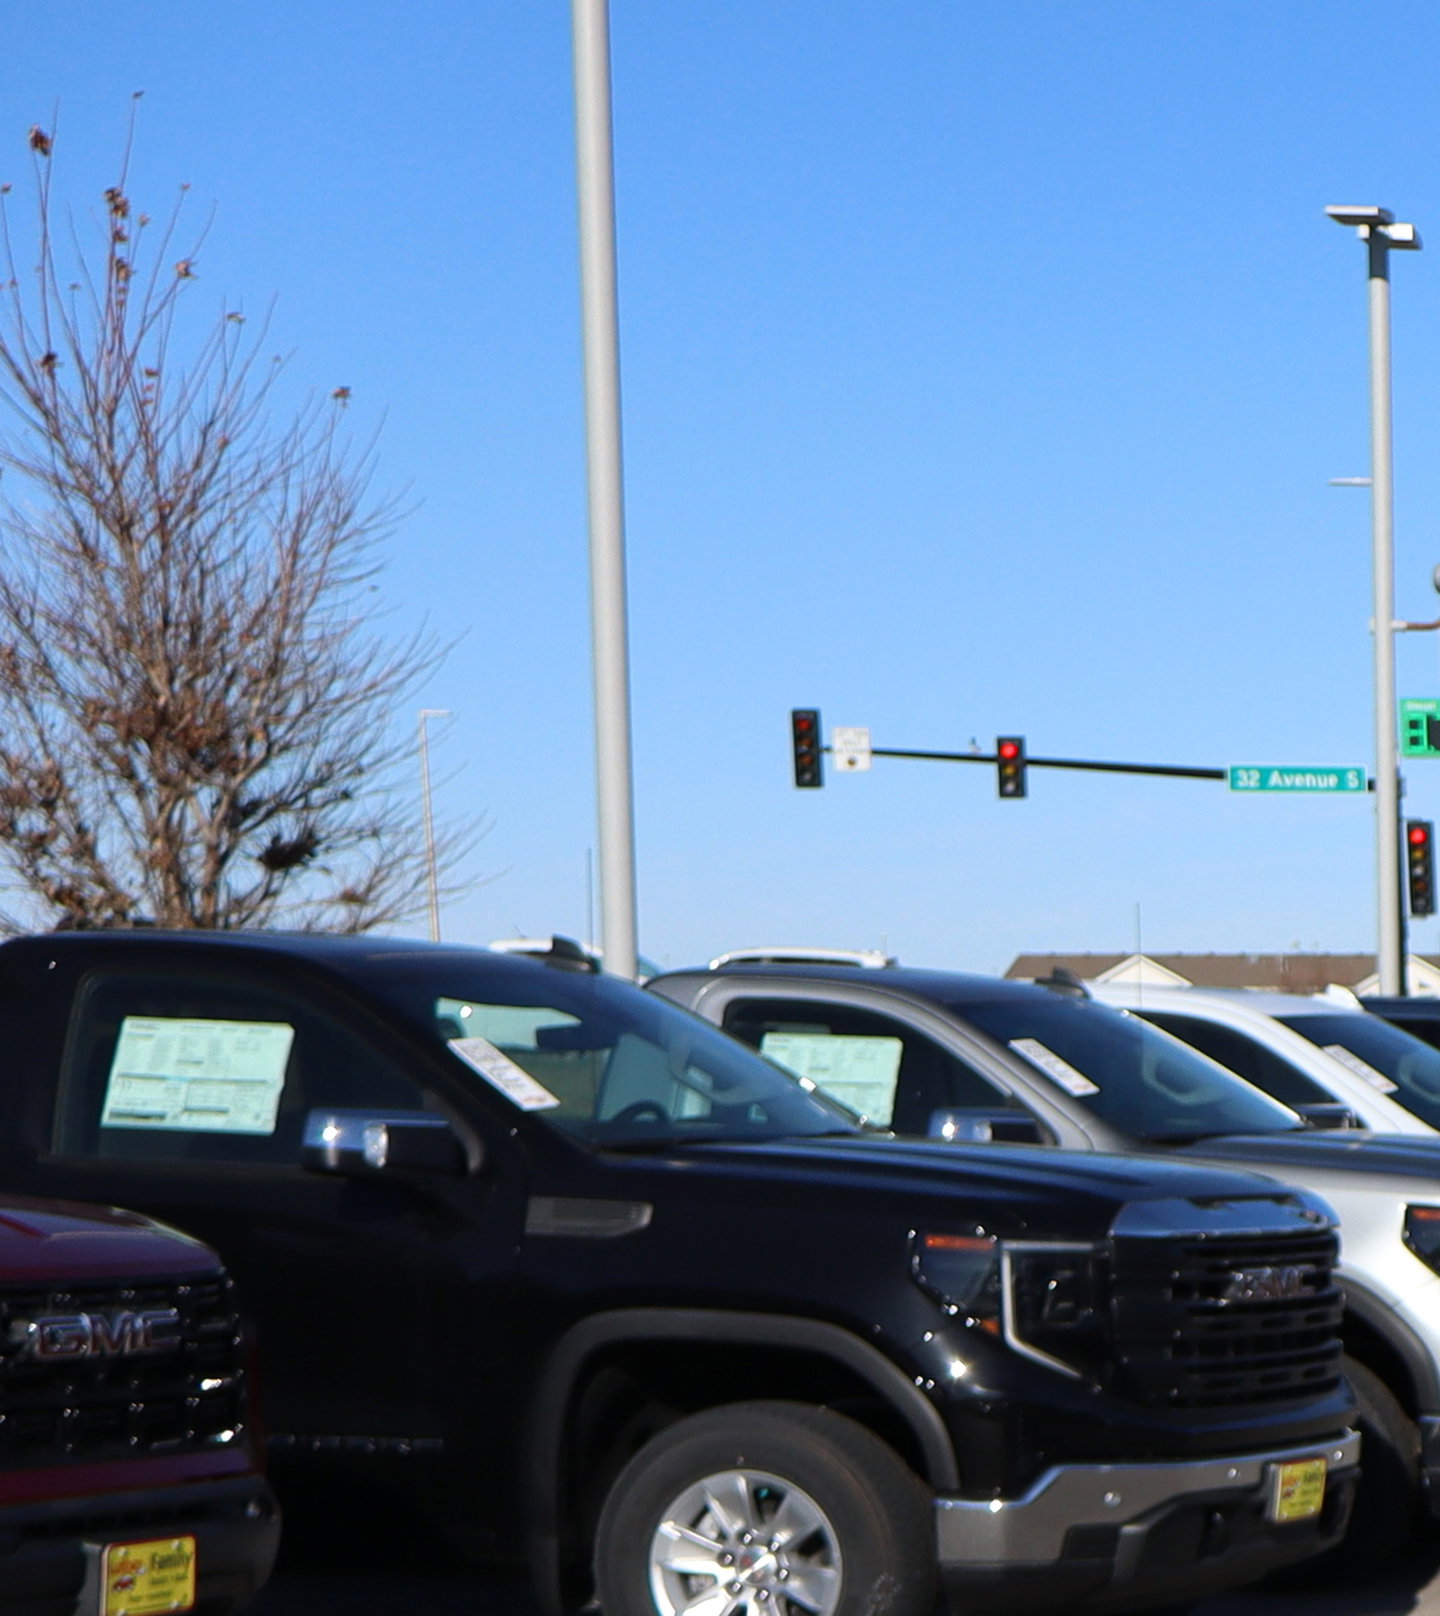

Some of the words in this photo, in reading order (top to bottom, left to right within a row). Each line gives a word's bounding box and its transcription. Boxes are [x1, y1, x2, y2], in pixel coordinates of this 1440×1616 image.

[1236, 768, 1261, 788] 32
[1267, 770, 1339, 788] Avenue
[1346, 770, 1360, 789] S
[35, 1307, 180, 1359] GMC
